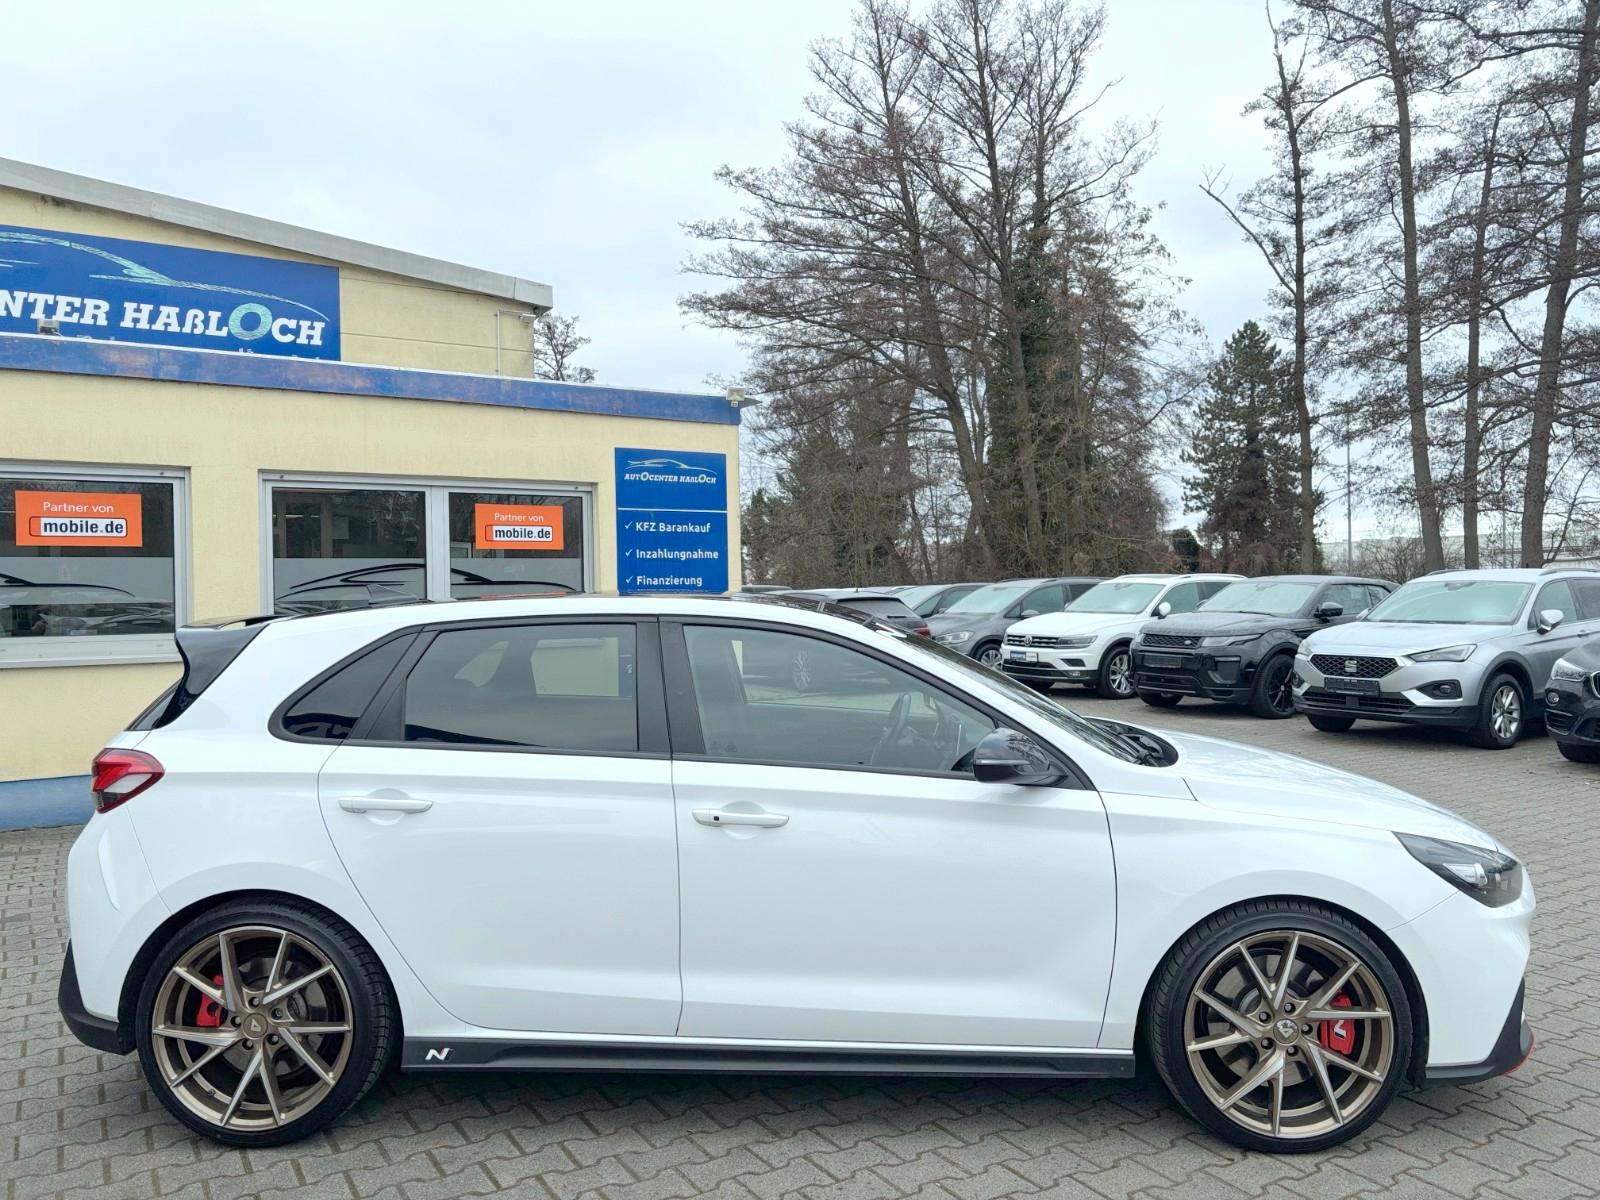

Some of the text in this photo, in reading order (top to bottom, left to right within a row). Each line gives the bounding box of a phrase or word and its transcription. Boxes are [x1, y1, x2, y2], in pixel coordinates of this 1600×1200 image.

[43, 502, 114, 513] Partner von
[494, 512, 527, 522] Partner
[43, 520, 124, 534] mobile.de
[636, 522, 711, 533] KFZ Barankauf
[494, 528, 551, 539] mobile.de
[636, 548, 719, 561] Inzahlungnahme
[636, 575, 703, 587] Finanzierung
